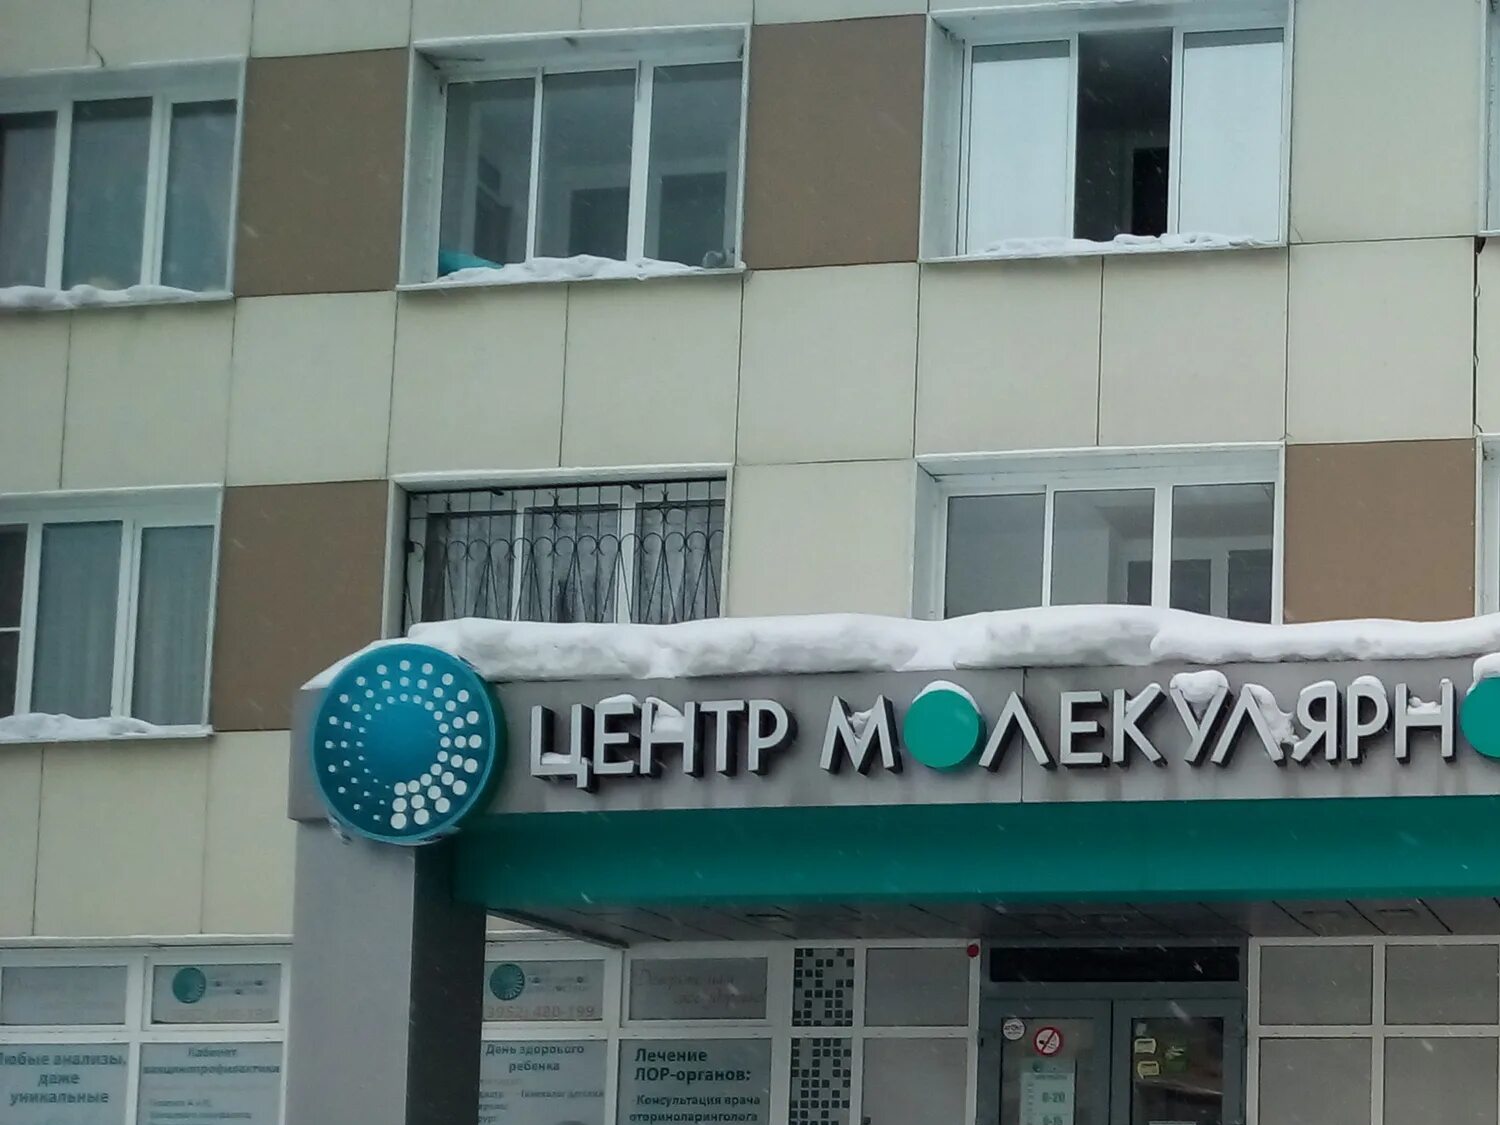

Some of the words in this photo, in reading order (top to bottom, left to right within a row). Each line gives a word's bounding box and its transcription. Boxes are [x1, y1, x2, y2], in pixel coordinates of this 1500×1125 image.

[530, 697, 796, 790] ЦЕНТР
[634, 1048, 708, 1063] Лечение
[634, 1067, 752, 1085] ЛОР-органов:
[10, 1091, 109, 1106] уникальные
[636, 1094, 722, 1108] Консультация
[724, 1096, 761, 1107] врача
